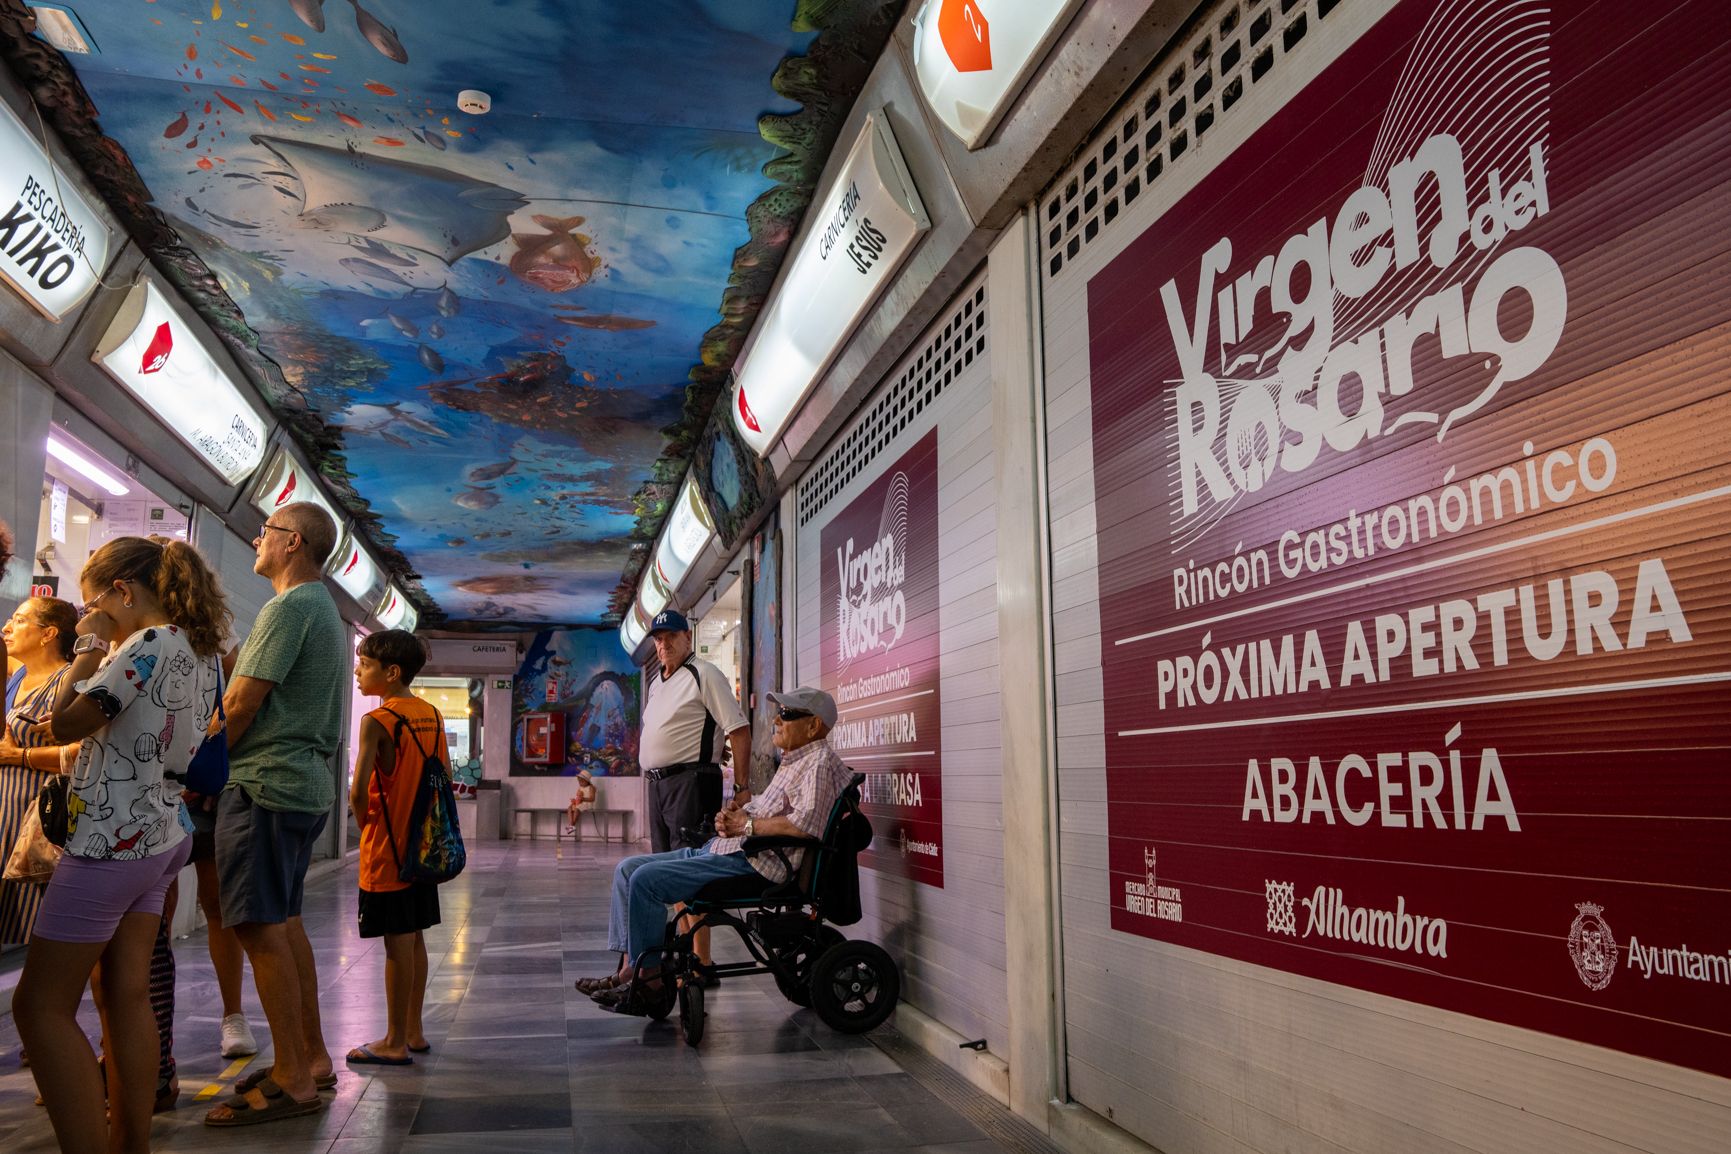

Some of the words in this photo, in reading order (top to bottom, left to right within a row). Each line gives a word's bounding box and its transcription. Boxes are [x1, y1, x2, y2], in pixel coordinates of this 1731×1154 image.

[964, 3, 982, 43] 2
[0, 200, 75, 290] KIKO
[21, 174, 86, 258] PESCADERÍA
[820, 178, 861, 260] CARNICERÍA
[846, 217, 887, 274] JESÚS
[1160, 132, 1470, 378] Virgen
[1470, 140, 1549, 250] del
[1173, 246, 1568, 517] Rosario
[1173, 540, 1270, 610] Rincón
[1278, 438, 1617, 579] Gastronómico
[837, 533, 894, 603] Virgen
[839, 590, 906, 661] Rosario
[1157, 630, 1331, 710] PRÓXIMA
[1340, 558, 1693, 688] APERTURA
[837, 677, 858, 704] Rincón
[858, 663, 910, 698] Gastronómico
[832, 716, 867, 750] PRÓXIMA
[868, 711, 917, 747] APERTURA
[886, 772, 923, 807] BRASA
[1242, 721, 1522, 832] ABACERÍA
[1125, 881, 1146, 896] MERCADO
[1157, 885, 1181, 902] MUNICIPAL
[1126, 893, 1146, 915] VIRGEN
[1145, 897, 1157, 918] DEL
[1157, 899, 1183, 923] ROSARIO
[1302, 885, 1447, 958] Alhambra
